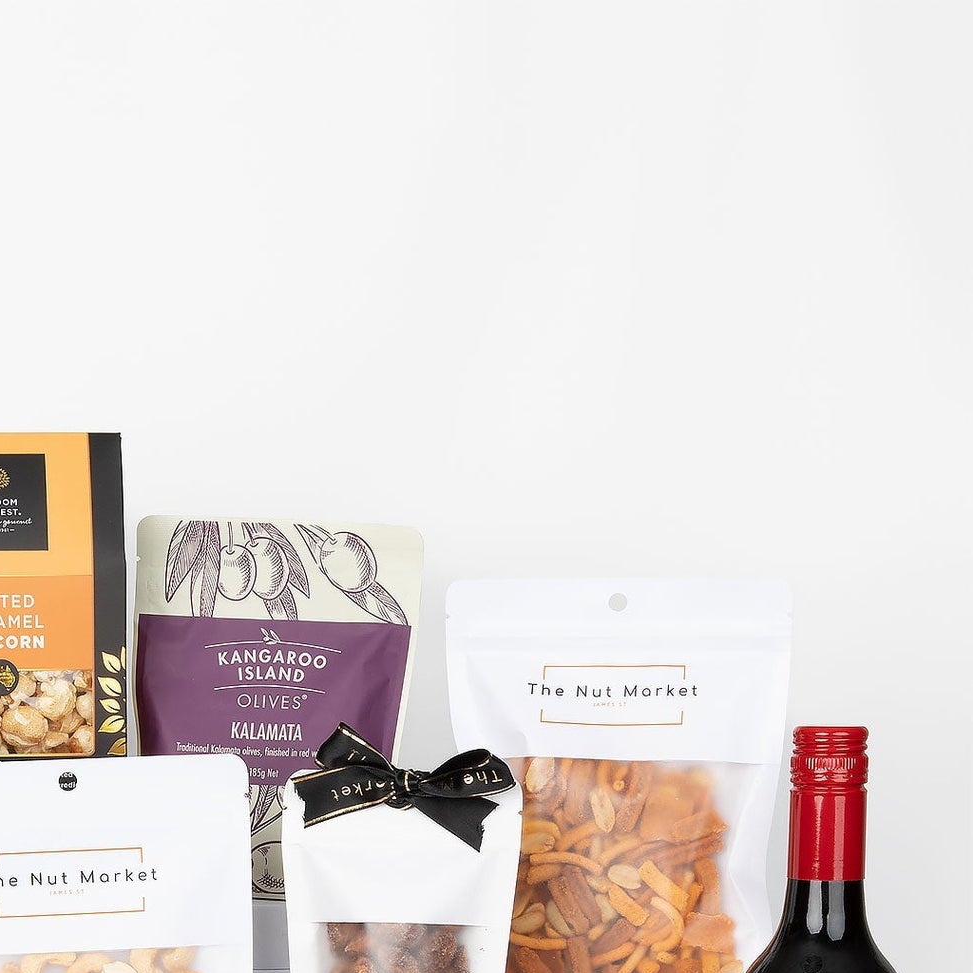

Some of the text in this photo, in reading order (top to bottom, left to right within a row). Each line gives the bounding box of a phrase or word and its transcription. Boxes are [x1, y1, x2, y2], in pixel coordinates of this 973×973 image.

[218, 649, 327, 669] KANGAROO
[237, 666, 305, 682] ISLAND
[527, 682, 698, 698] The Nut Market
[230, 721, 303, 741] KALAMATA
[176, 741, 209, 753] Traditional
[242, 746, 263, 758] olives,
[264, 746, 290, 757] finished
[291, 748, 298, 757] in
[299, 748, 310, 757] red
[267, 768, 279, 778] Net
[30, 871, 68, 886] Nut
[80, 867, 158, 884] Market
